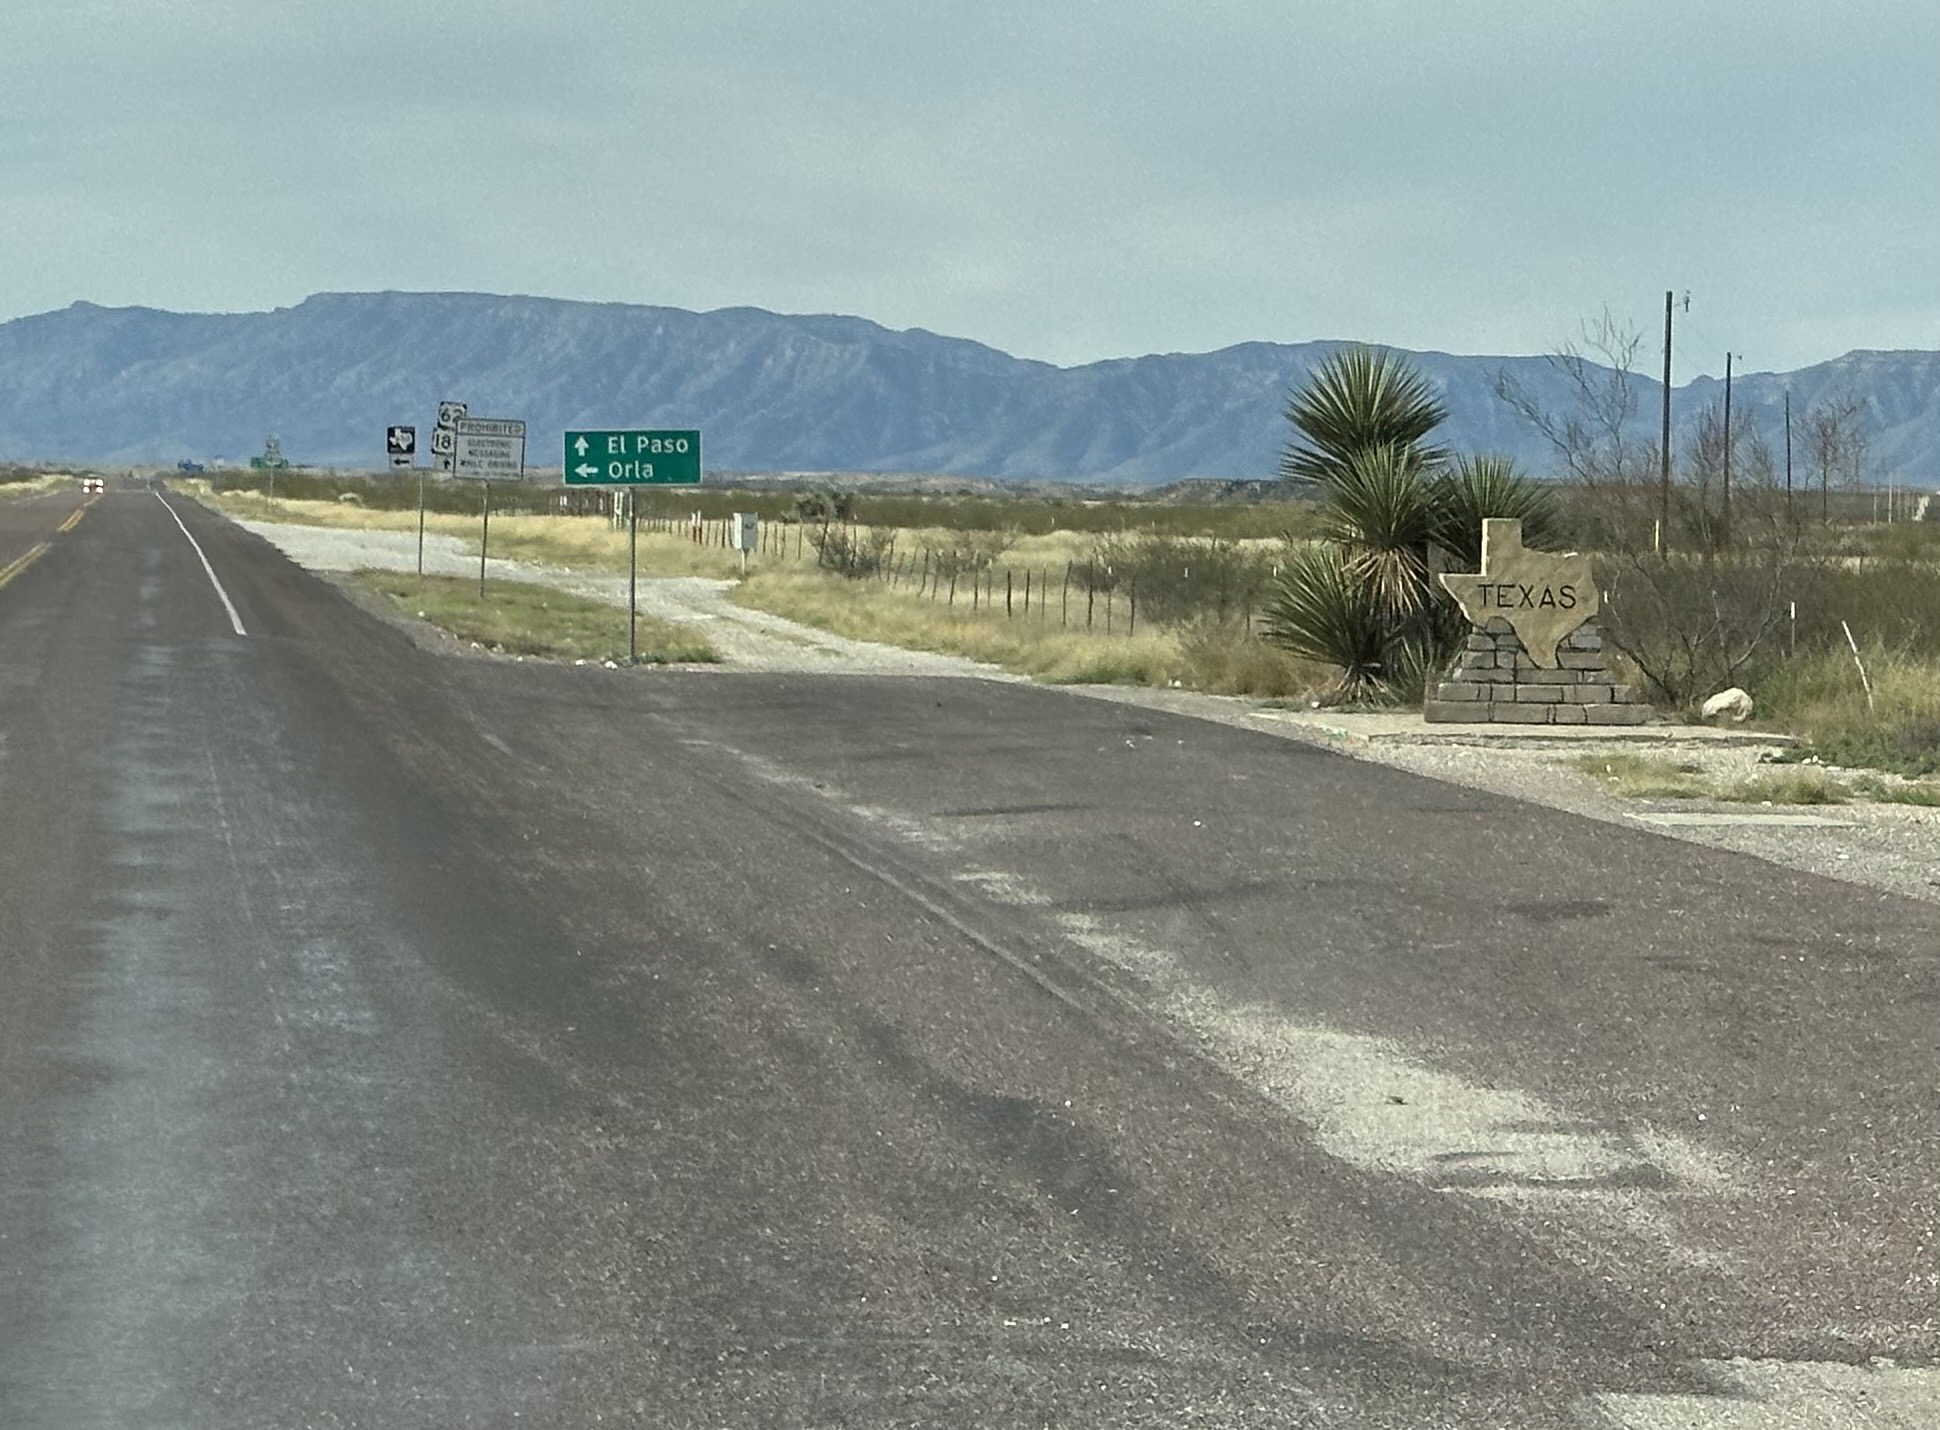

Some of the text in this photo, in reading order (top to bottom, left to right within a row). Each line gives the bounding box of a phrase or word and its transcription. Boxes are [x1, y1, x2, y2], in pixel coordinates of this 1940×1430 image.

[460, 422, 522, 433] PROHIBITED
[435, 433, 451, 449] 18
[608, 435, 689, 454] El Paso
[608, 460, 654, 479] Orla
[1477, 583, 1577, 609] TEXAS
